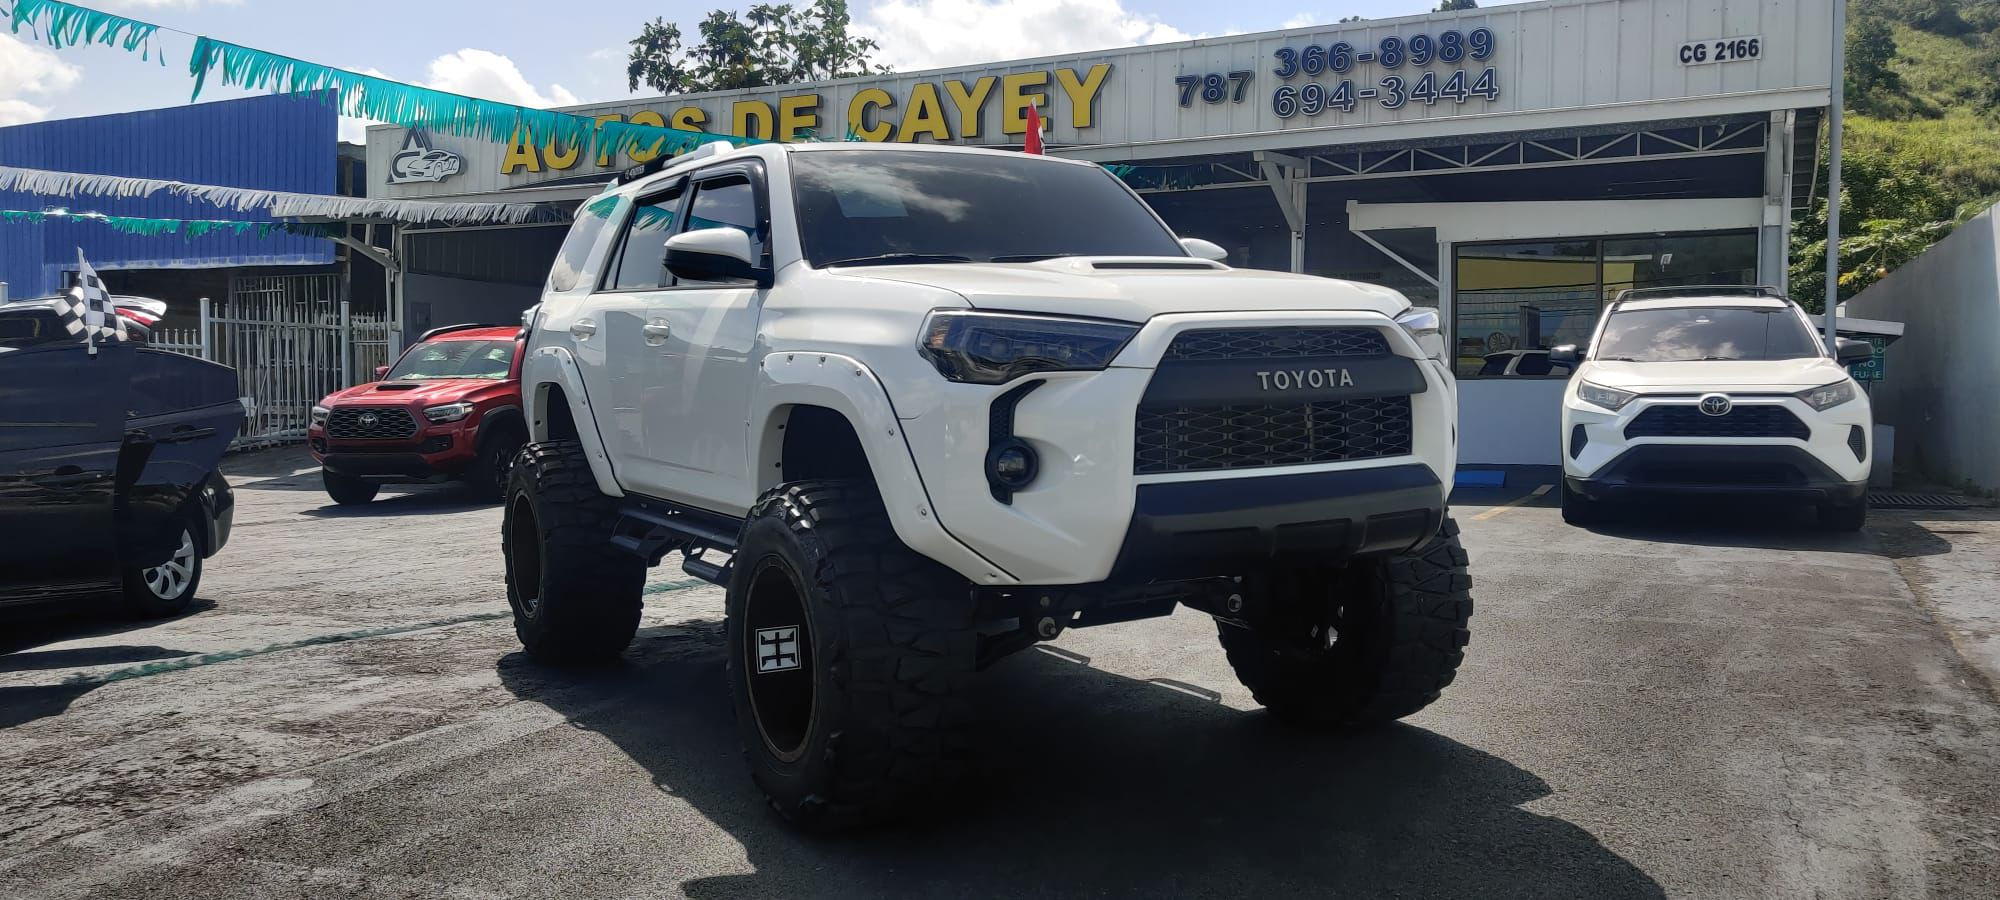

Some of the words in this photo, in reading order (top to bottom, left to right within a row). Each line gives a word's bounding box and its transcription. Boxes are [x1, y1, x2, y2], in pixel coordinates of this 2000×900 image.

[1273, 27, 1496, 79] 366-8989
[1680, 43, 1707, 63] CG
[1714, 38, 1760, 61] 2166
[731, 94, 820, 142] DE
[848, 63, 1112, 142] CAYEY
[1175, 70, 1256, 108] 787
[1271, 66, 1499, 118] 694-3444
[1256, 368, 1354, 391] TOYOTA
